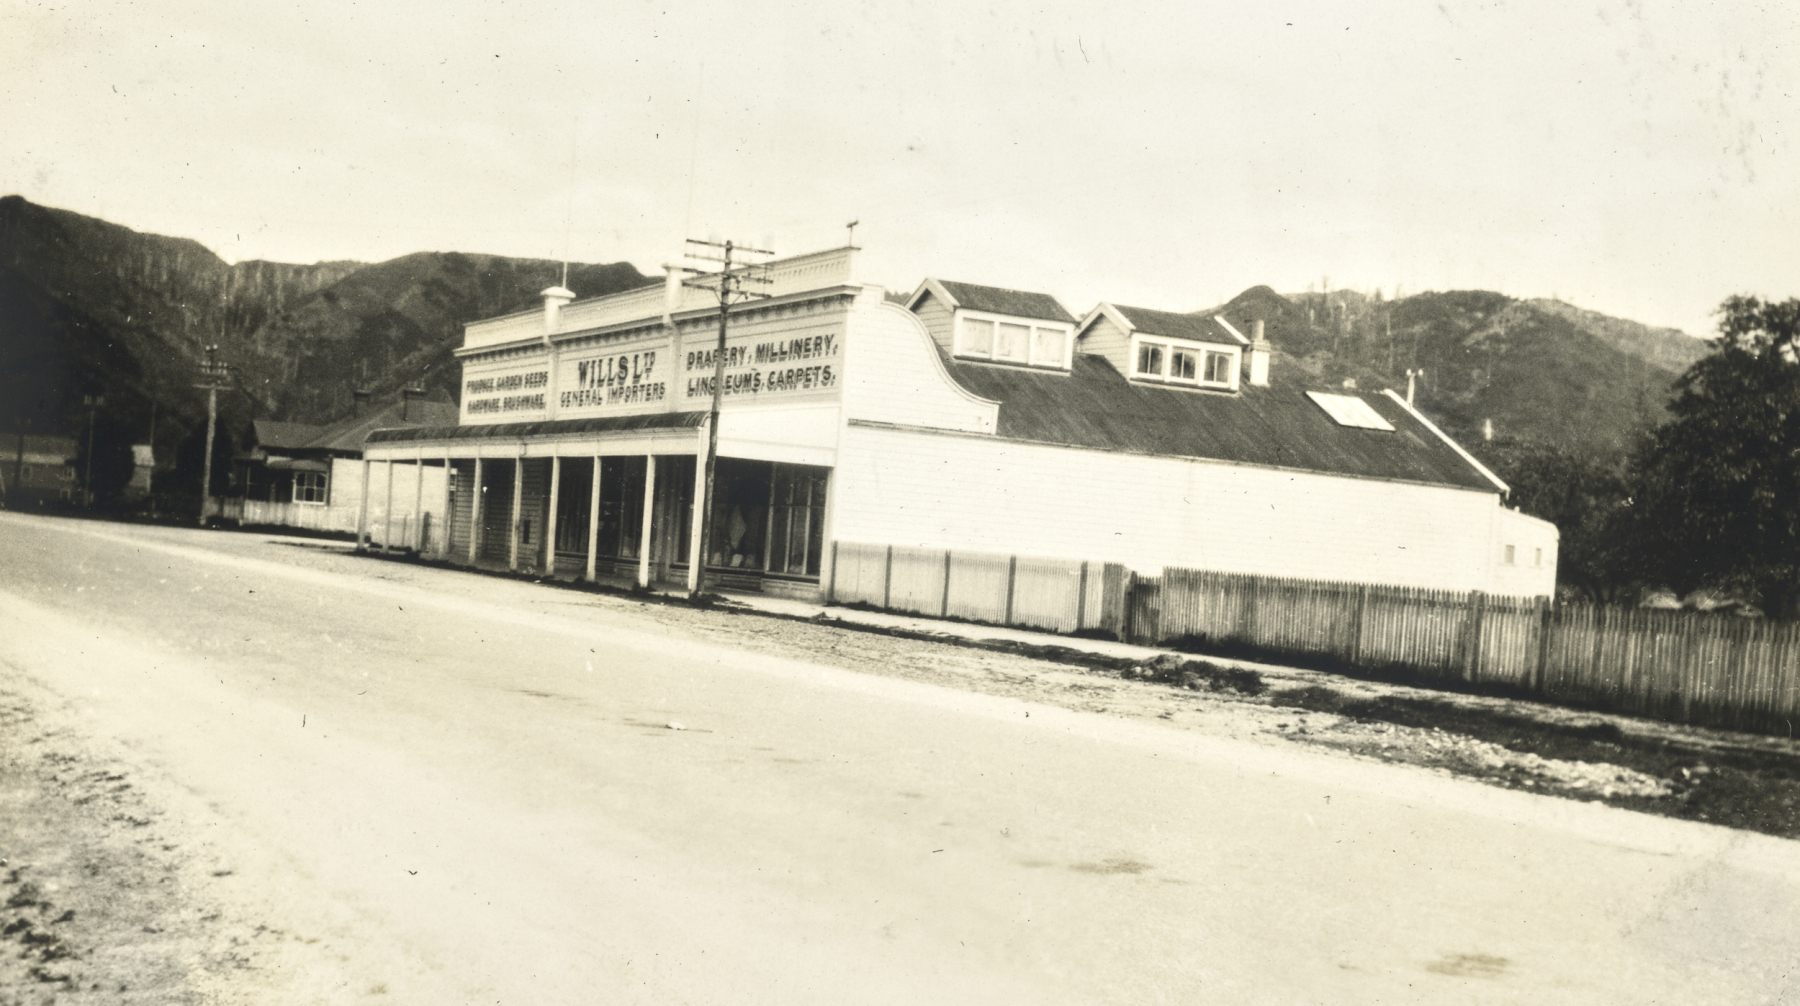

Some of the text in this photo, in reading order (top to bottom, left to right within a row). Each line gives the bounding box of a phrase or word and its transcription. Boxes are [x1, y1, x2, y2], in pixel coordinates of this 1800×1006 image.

[755, 333, 839, 363] MILLINERY,
[524, 371, 548, 388] SEEDS
[578, 355, 629, 389] WILLS
[687, 371, 765, 397] LINOEUMS,
[560, 381, 666, 407] GENERAL IMPORTERS
